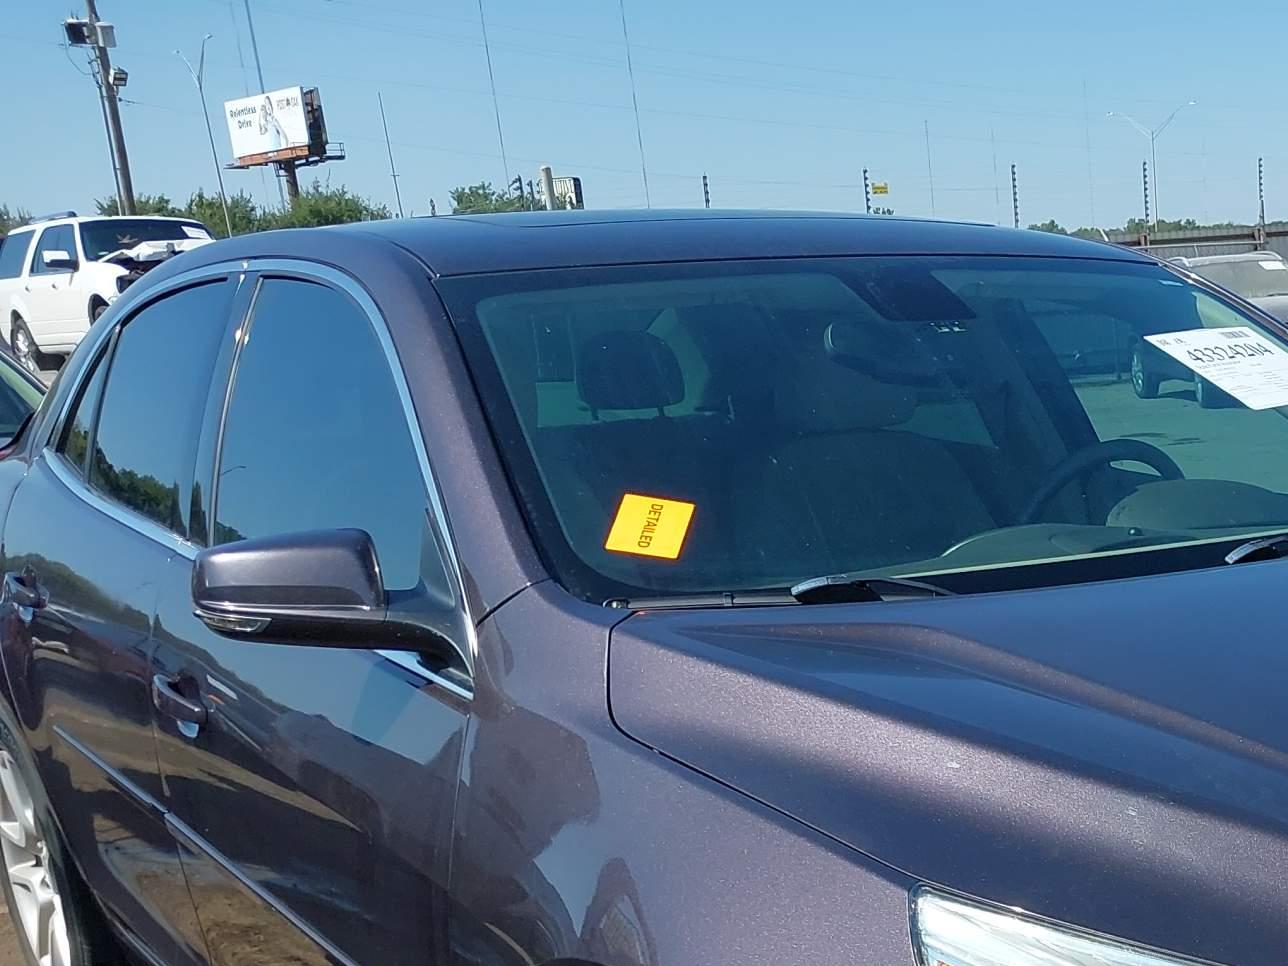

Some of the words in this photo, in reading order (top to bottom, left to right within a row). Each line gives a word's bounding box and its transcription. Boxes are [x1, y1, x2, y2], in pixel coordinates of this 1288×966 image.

[229, 105, 257, 118] Relentless
[237, 119, 253, 130] Drive
[1186, 341, 1275, 364] 43324204
[637, 503, 664, 549] DETAILED
